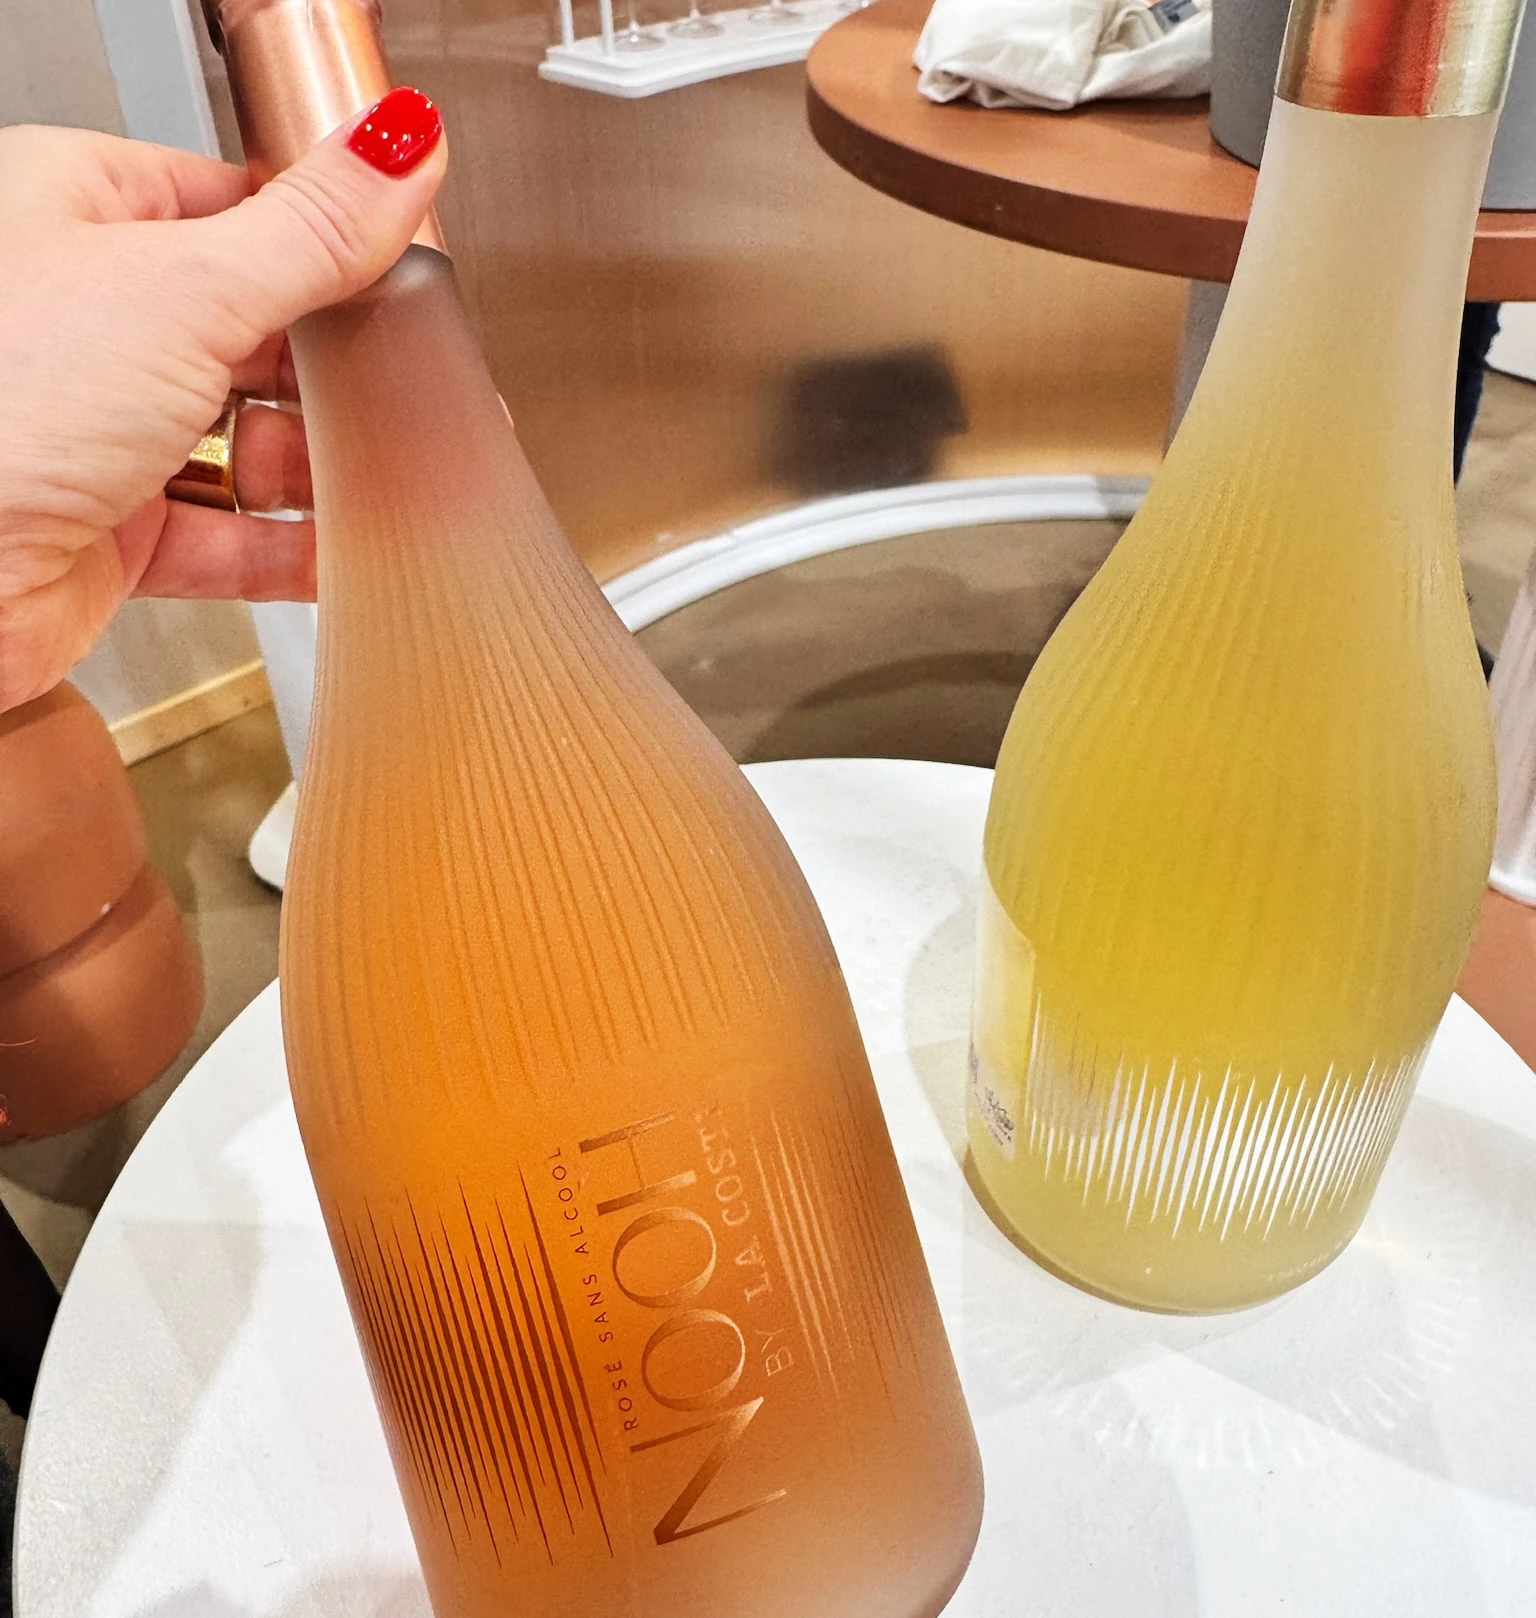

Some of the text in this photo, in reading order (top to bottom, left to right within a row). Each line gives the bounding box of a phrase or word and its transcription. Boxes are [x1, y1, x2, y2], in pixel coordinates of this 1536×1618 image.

[549, 1147, 638, 1431] ROSÉ SANS ALCOOL
[578, 1110, 787, 1546] NOOH
[755, 1325, 795, 1377] BY
